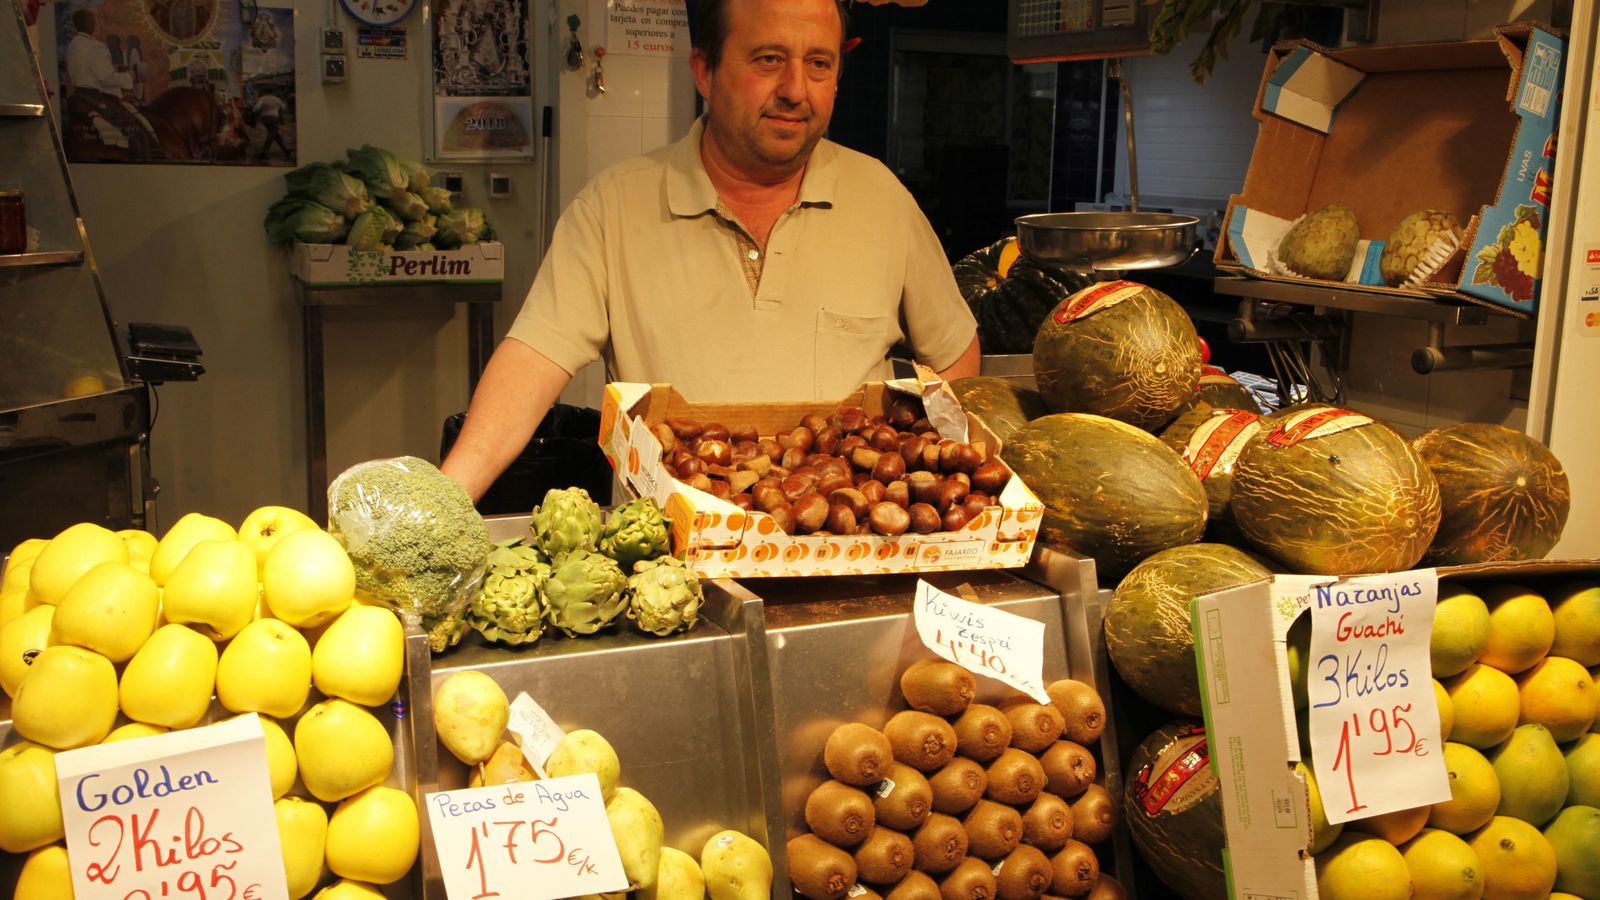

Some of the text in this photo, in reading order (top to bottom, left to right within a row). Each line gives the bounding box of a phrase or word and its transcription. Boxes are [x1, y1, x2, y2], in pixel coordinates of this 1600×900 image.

[614, 3, 644, 14] Puedes
[647, 7, 669, 17] pagar
[610, 14, 636, 25] tarjeta
[625, 28, 668, 38] superiores
[627, 39, 674, 51] 15 euros
[464, 117, 505, 130] 2018
[1517, 150, 1532, 182] UVAS
[389, 255, 472, 276] Perlim
[944, 548, 978, 556] FAJARDO
[925, 586, 985, 629] Kiwis
[1336, 611, 1405, 642] Guachi
[76, 765, 218, 812] Golden
[502, 787, 525, 806] de
[535, 783, 591, 811] Agua
